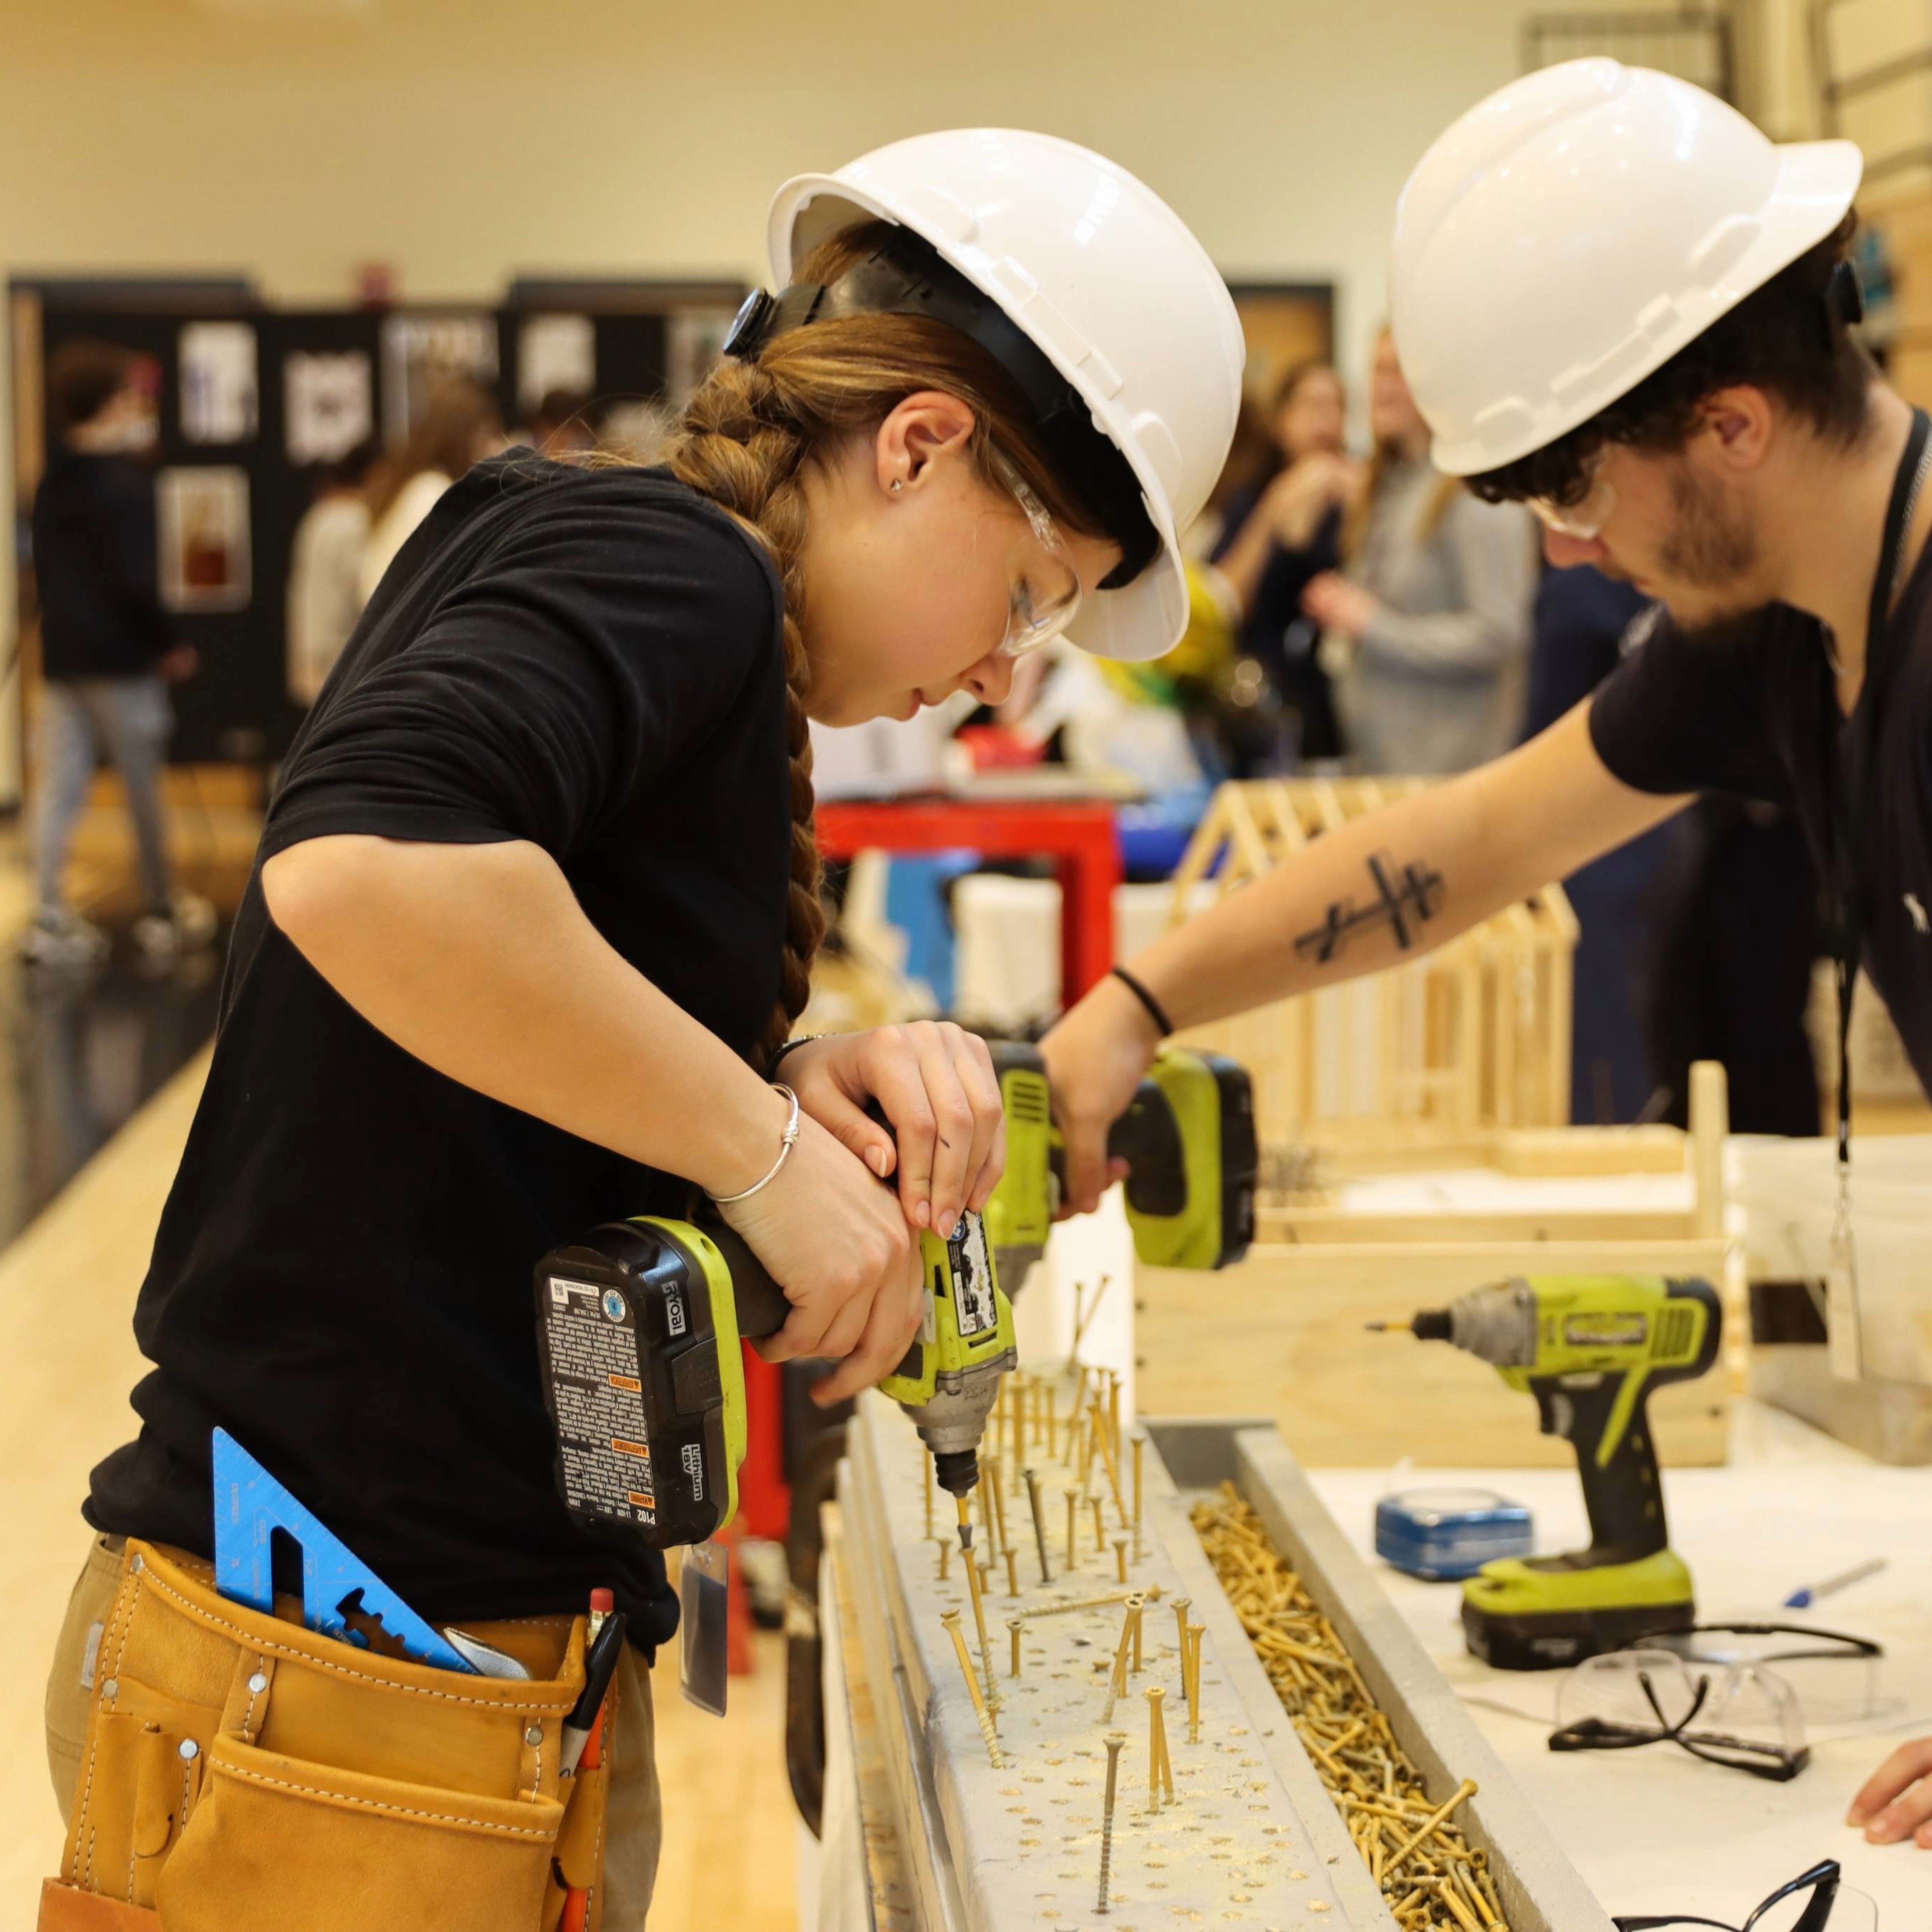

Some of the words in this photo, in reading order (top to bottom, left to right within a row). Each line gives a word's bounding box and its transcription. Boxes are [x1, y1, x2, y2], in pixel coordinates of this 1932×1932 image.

[665, 1283, 682, 1330] RYOBI
[610, 1375, 634, 1389] ADVERTENCIA
[613, 1440, 642, 1454] AVERTISSEMENT
[683, 1447, 692, 1472] 18V
[691, 1446, 702, 1499] Lithium
[630, 1494, 649, 1505] WARNING
[617, 1509, 631, 1518] LI-ION
[637, 1509, 655, 1524] P102
